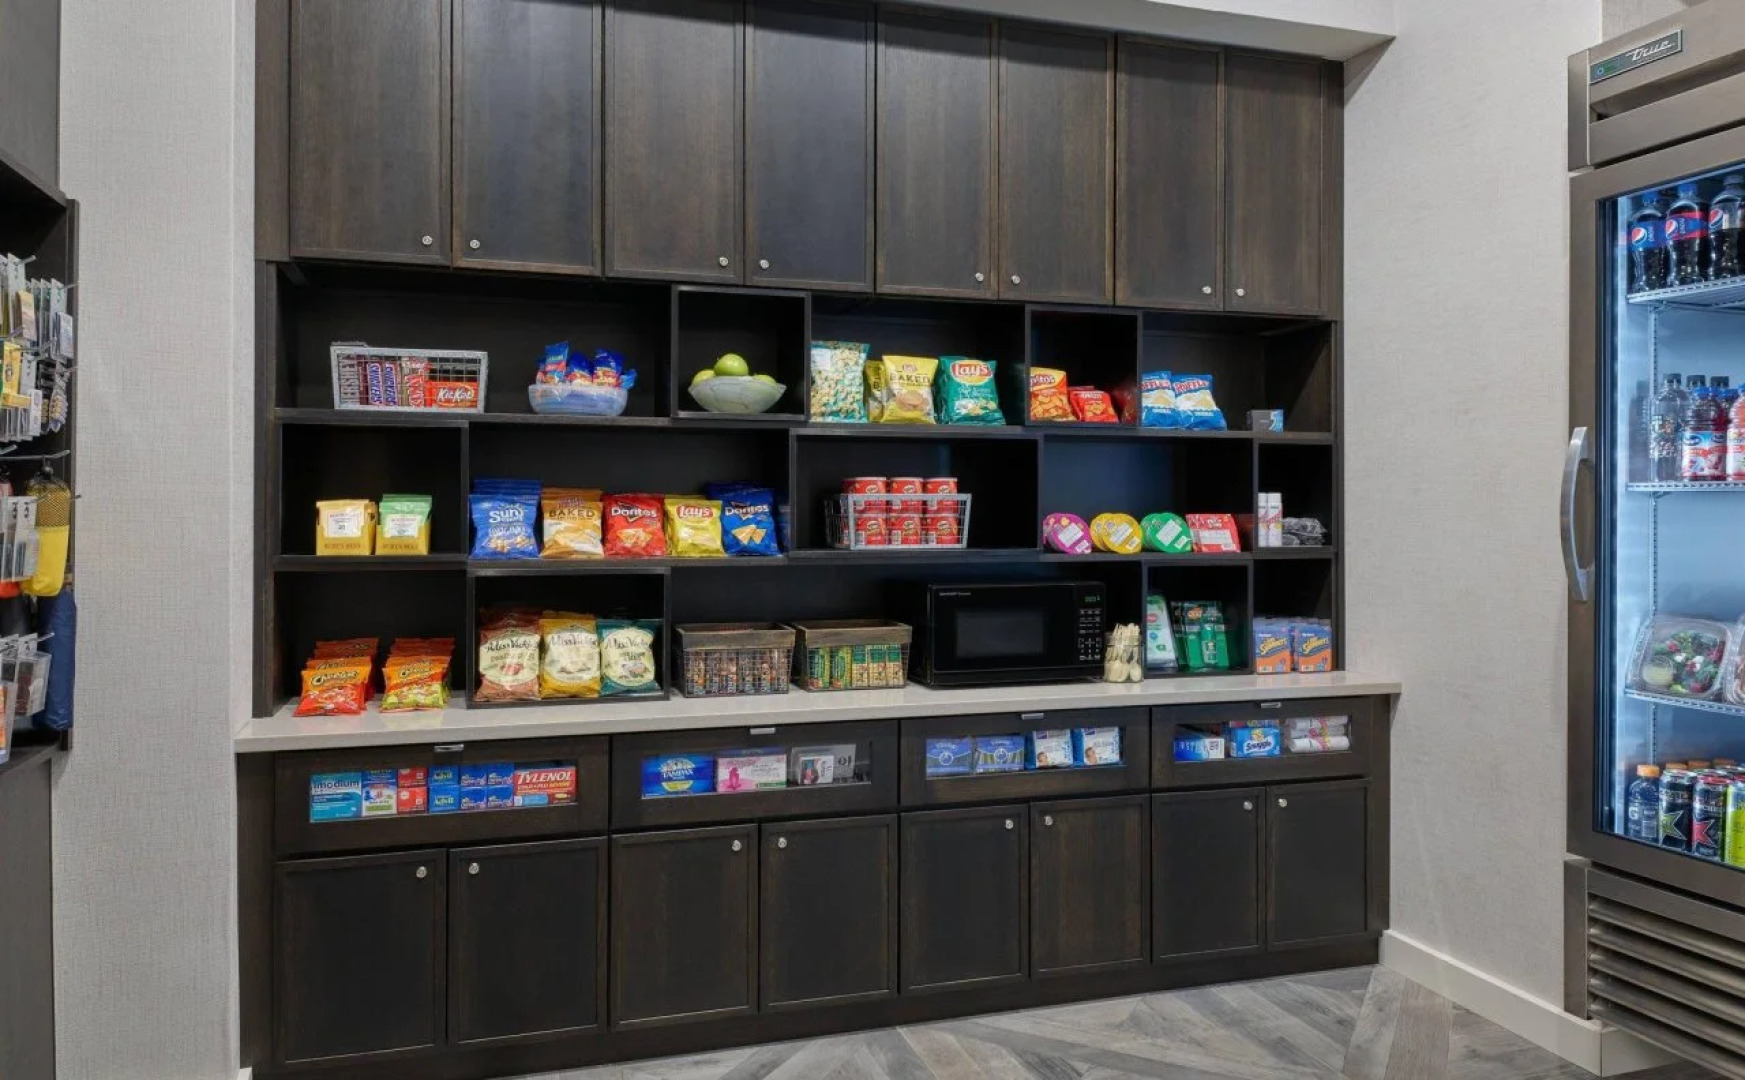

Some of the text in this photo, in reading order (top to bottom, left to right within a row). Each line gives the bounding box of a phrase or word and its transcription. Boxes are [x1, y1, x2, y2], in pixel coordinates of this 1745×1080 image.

[549, 508, 595, 518] BAKED
[611, 506, 657, 518] Doritos
[725, 504, 769, 516] Doritos
[517, 771, 572, 785] TYLENOL
